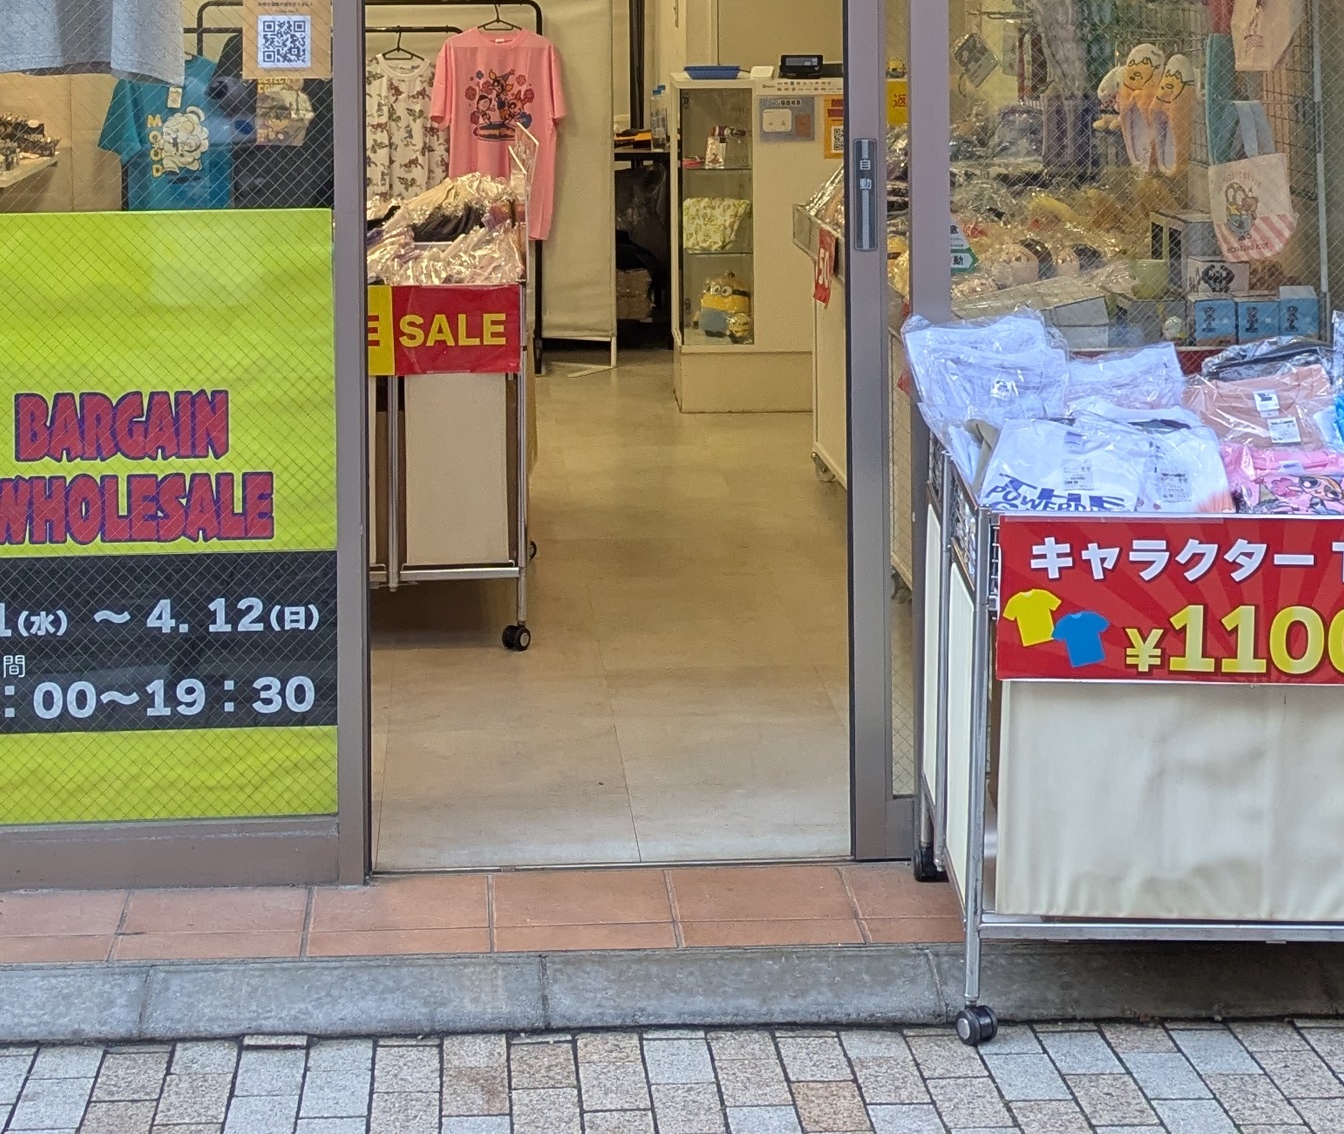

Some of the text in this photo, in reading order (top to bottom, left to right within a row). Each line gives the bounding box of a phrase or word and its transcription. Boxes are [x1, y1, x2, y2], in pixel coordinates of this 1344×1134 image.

[859, 159, 872, 190] 自動
[398, 313, 507, 348] SALE
[14, 389, 230, 464] BARGAIN
